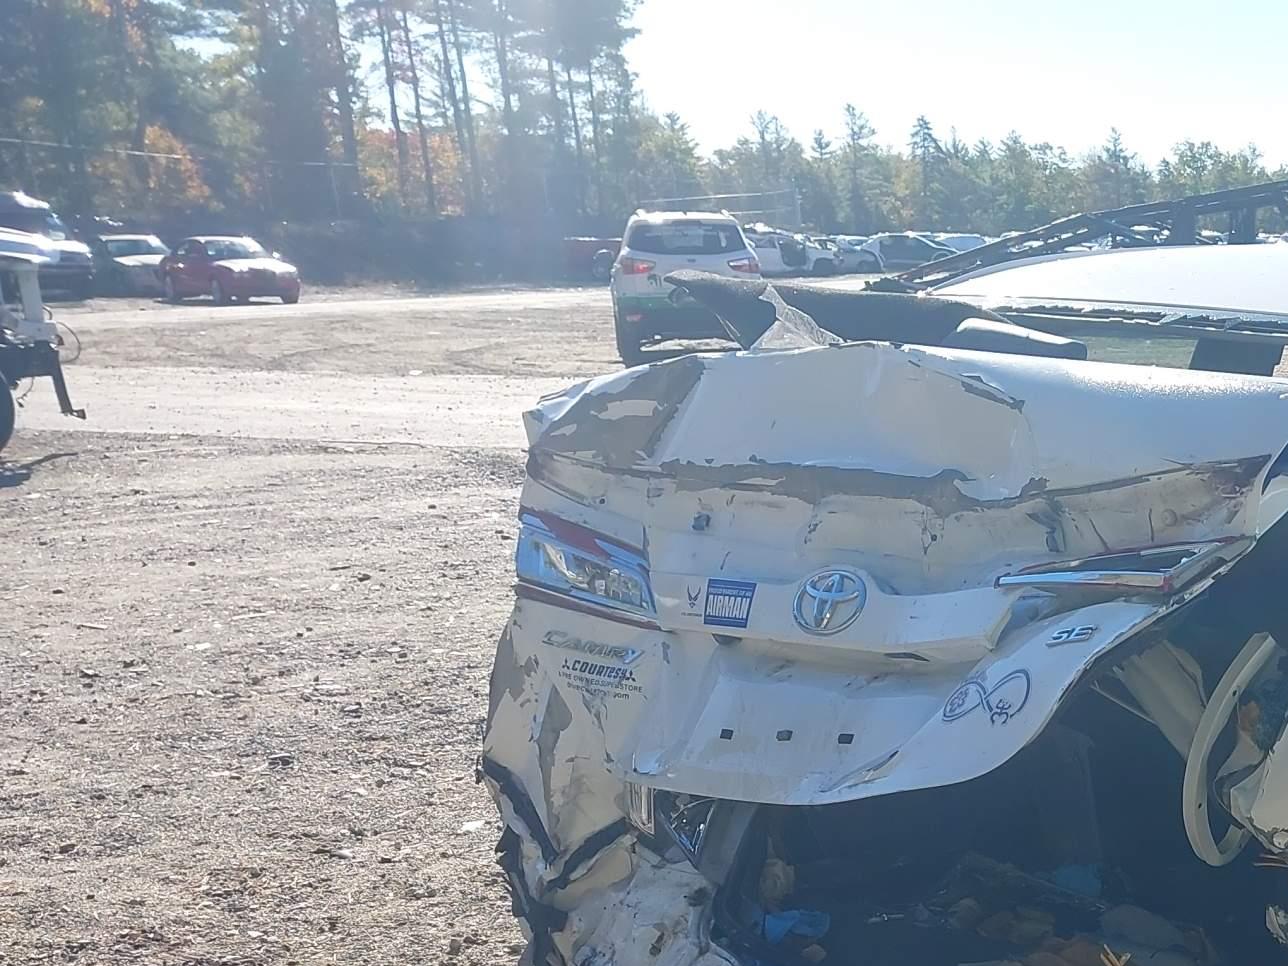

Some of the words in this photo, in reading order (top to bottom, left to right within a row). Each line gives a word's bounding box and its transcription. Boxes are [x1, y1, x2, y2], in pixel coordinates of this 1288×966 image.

[706, 594, 751, 619] AIRMAN
[542, 630, 645, 664] CAMRY
[1046, 625, 1097, 647] SE
